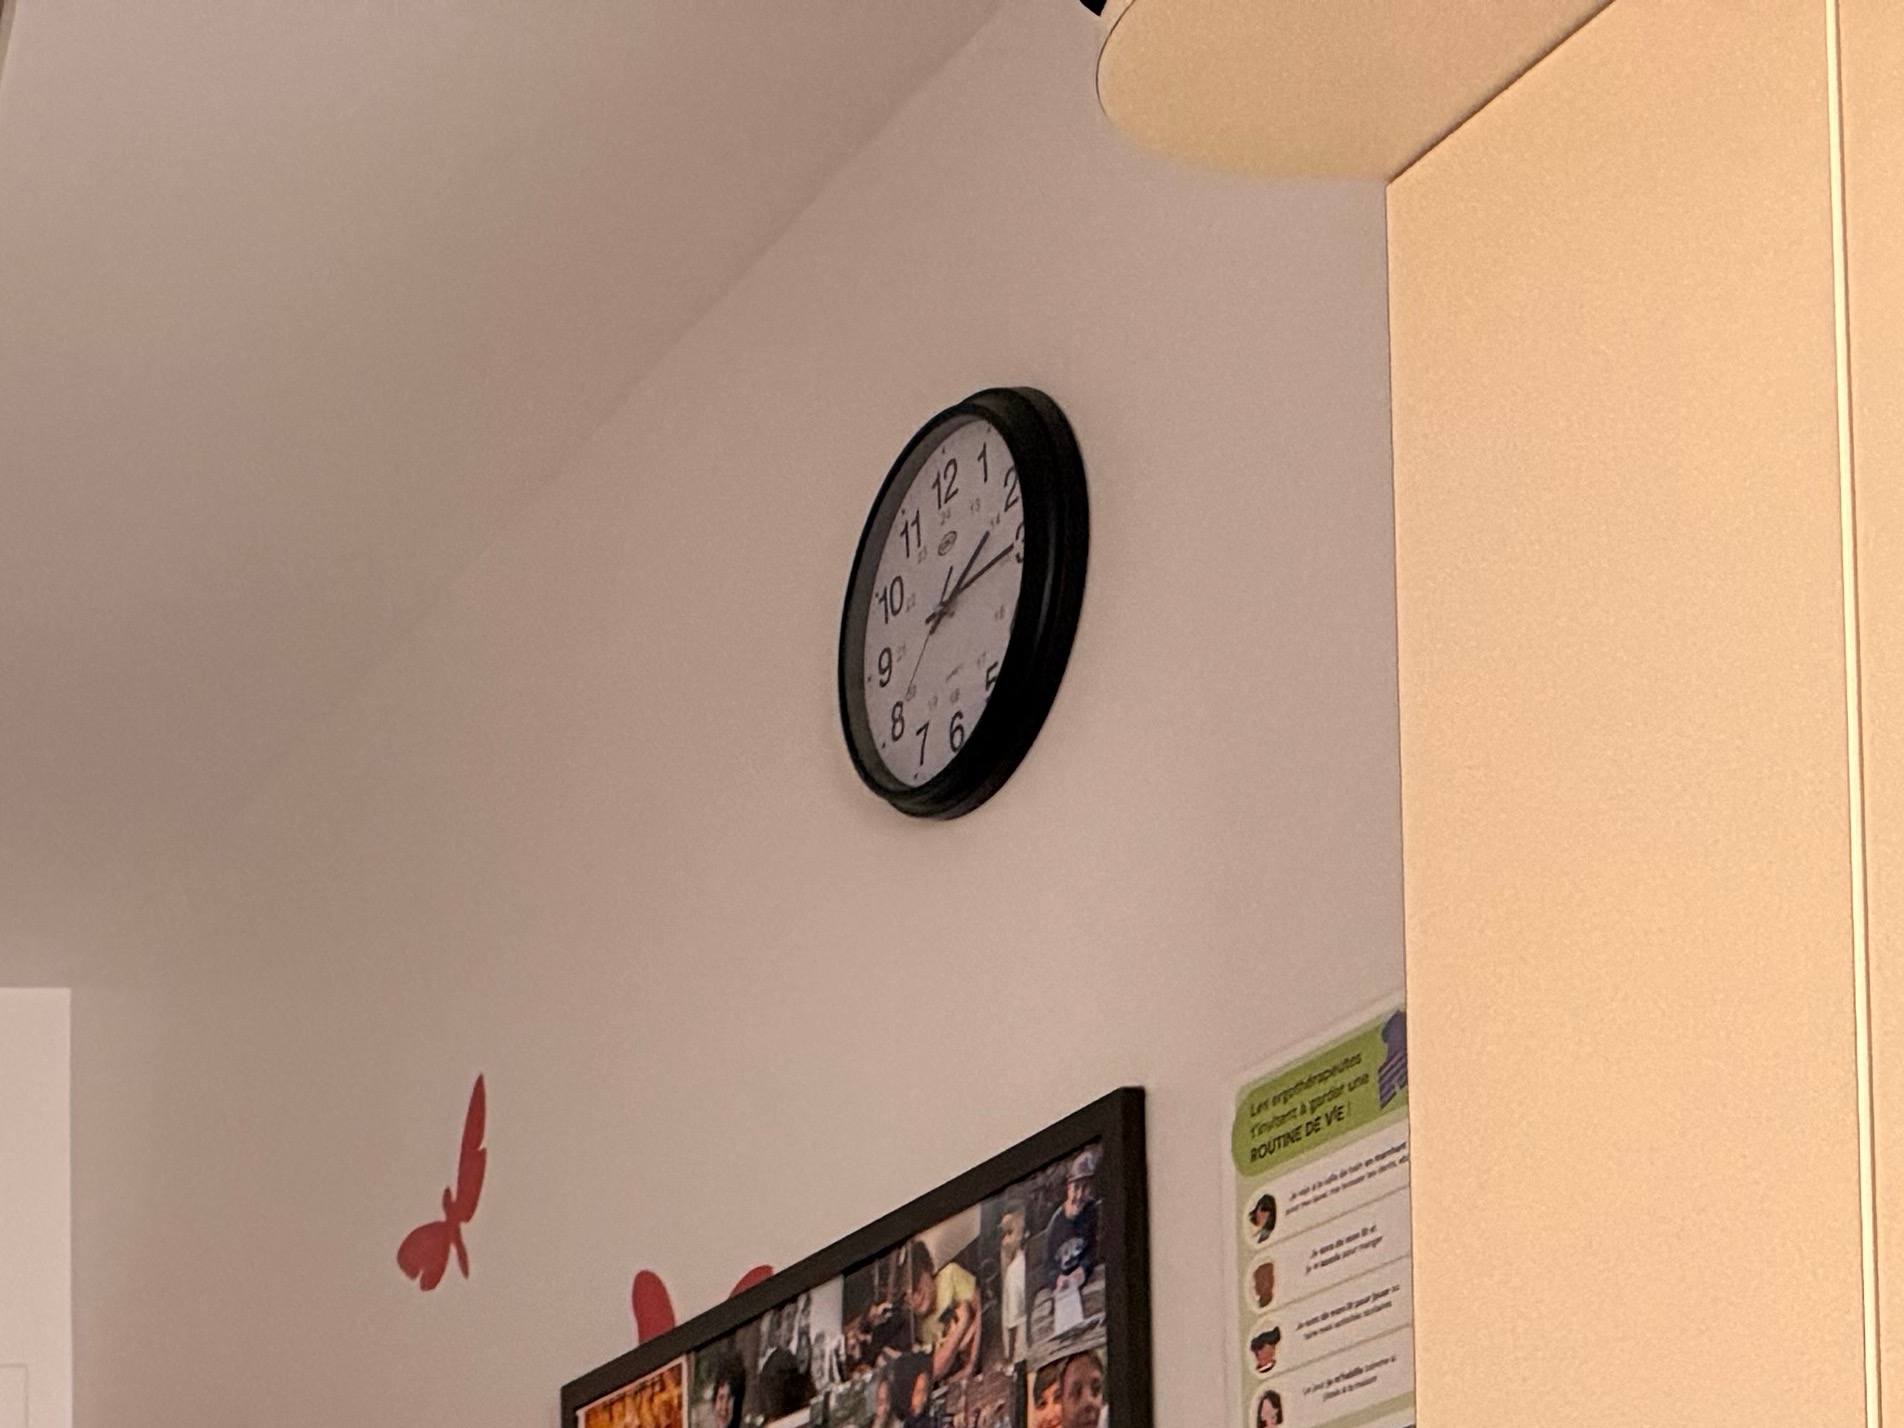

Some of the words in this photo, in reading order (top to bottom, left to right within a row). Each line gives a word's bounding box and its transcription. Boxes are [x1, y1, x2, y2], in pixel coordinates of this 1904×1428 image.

[931, 457, 959, 511] 12
[977, 442, 989, 483] 1
[1003, 464, 1024, 513] 2
[899, 509, 925, 559] 11
[878, 575, 905, 625] 10
[877, 647, 893, 688] 9
[891, 700, 906, 742] 8
[915, 721, 930, 767] 7
[949, 710, 965, 753] 6
[1250, 1125, 1303, 1164] ROUTINE
[1305, 1115, 1322, 1138] DE
[1325, 1104, 1346, 1127] VIE
